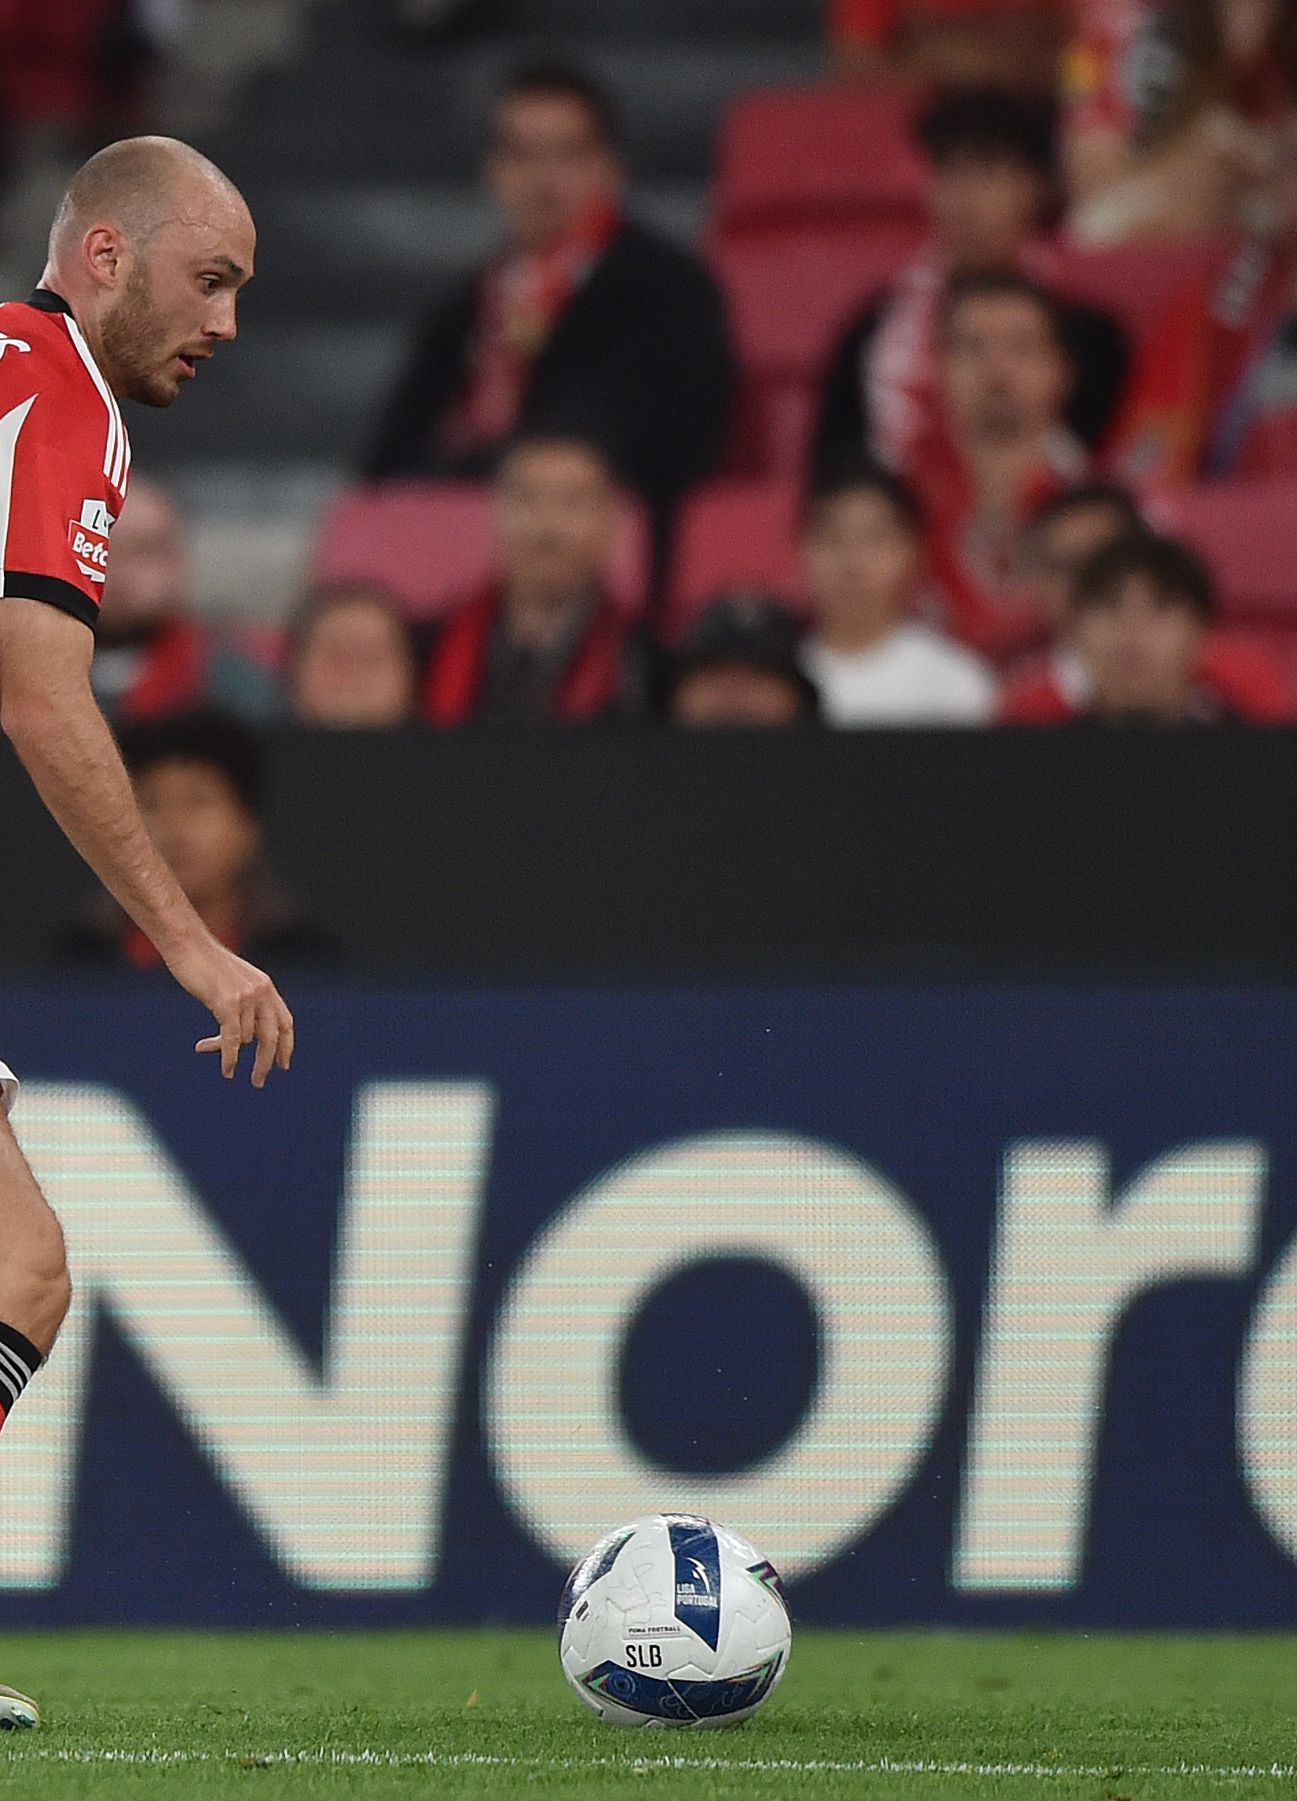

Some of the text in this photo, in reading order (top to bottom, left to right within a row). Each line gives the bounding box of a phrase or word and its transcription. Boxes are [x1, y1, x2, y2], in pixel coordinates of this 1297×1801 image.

[676, 1583, 696, 1594] LIGA
[676, 1594, 719, 1609] PORTUGAL
[625, 1644, 663, 1668] SLB
